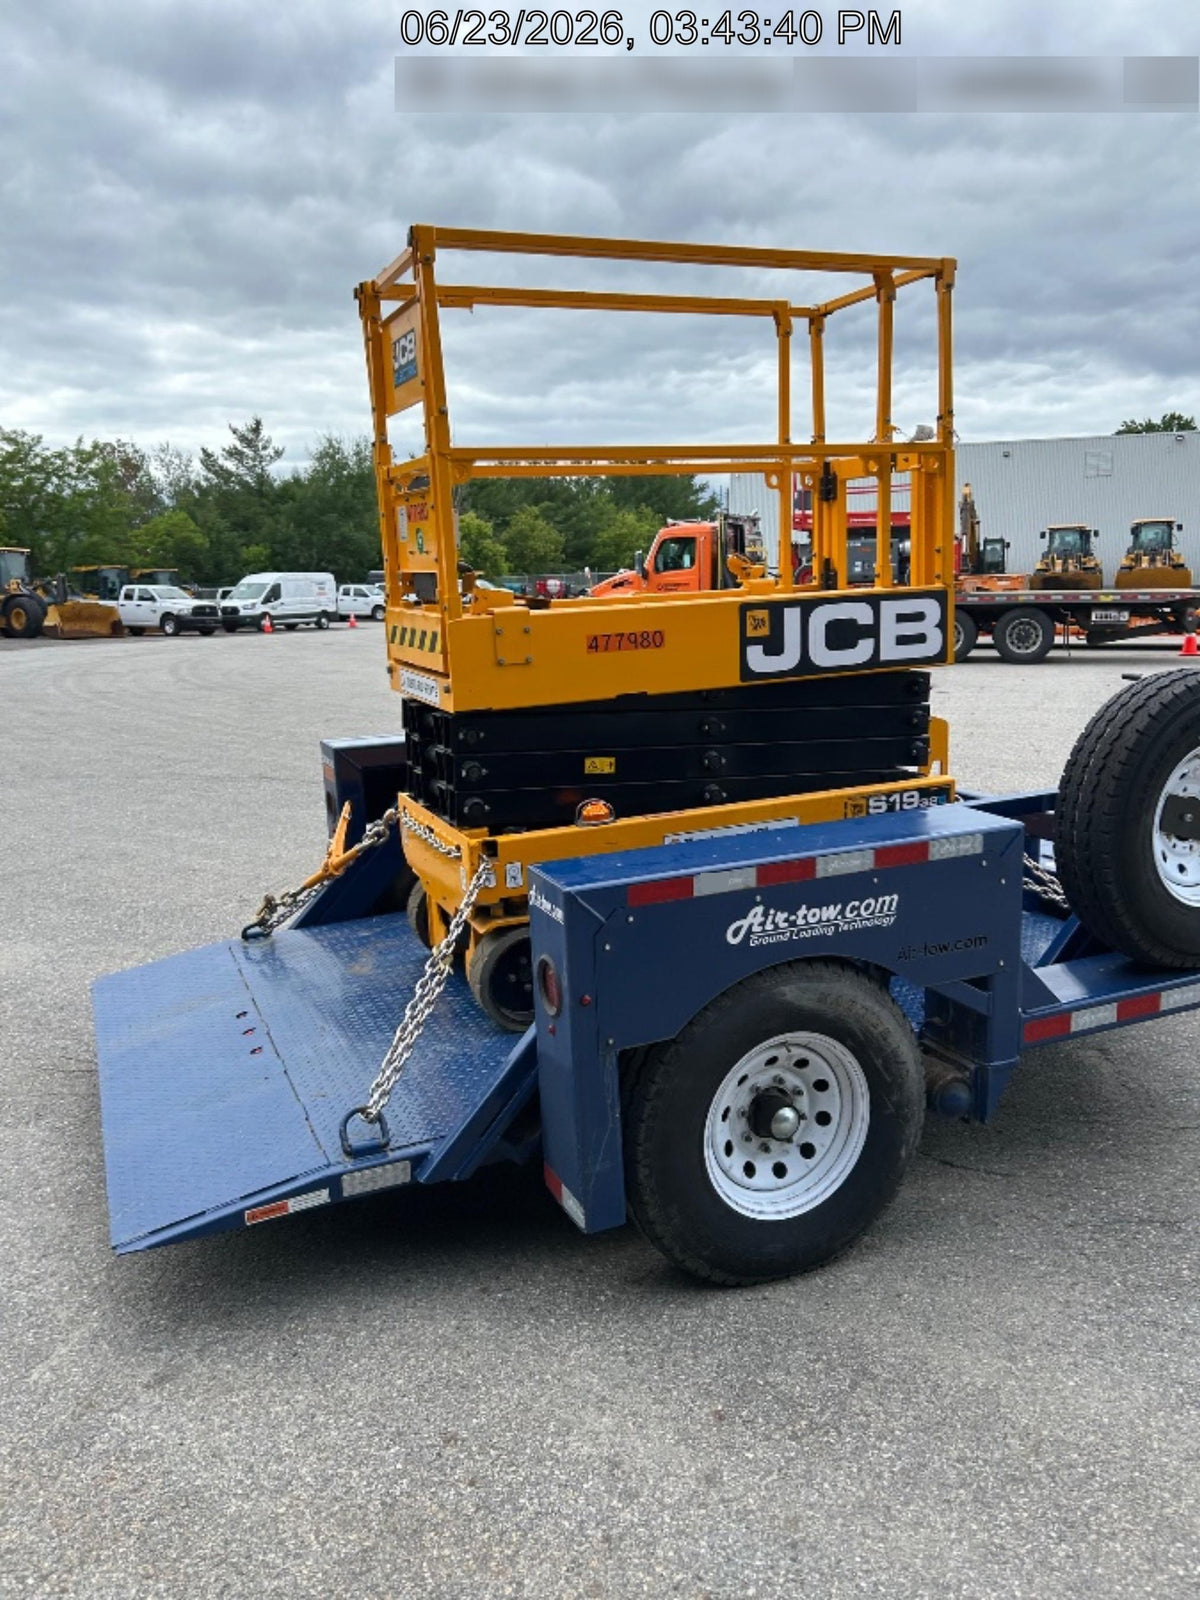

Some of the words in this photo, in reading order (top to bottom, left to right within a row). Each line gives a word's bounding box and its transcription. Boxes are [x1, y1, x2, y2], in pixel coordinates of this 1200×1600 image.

[394, 332, 416, 370] JCB
[588, 630, 665, 653] 477980
[746, 598, 943, 673] JCB
[726, 894, 899, 945] Air-tow.com
[749, 931, 790, 947] Ground
[792, 925, 835, 940] Loading
[839, 915, 897, 932] Technology
